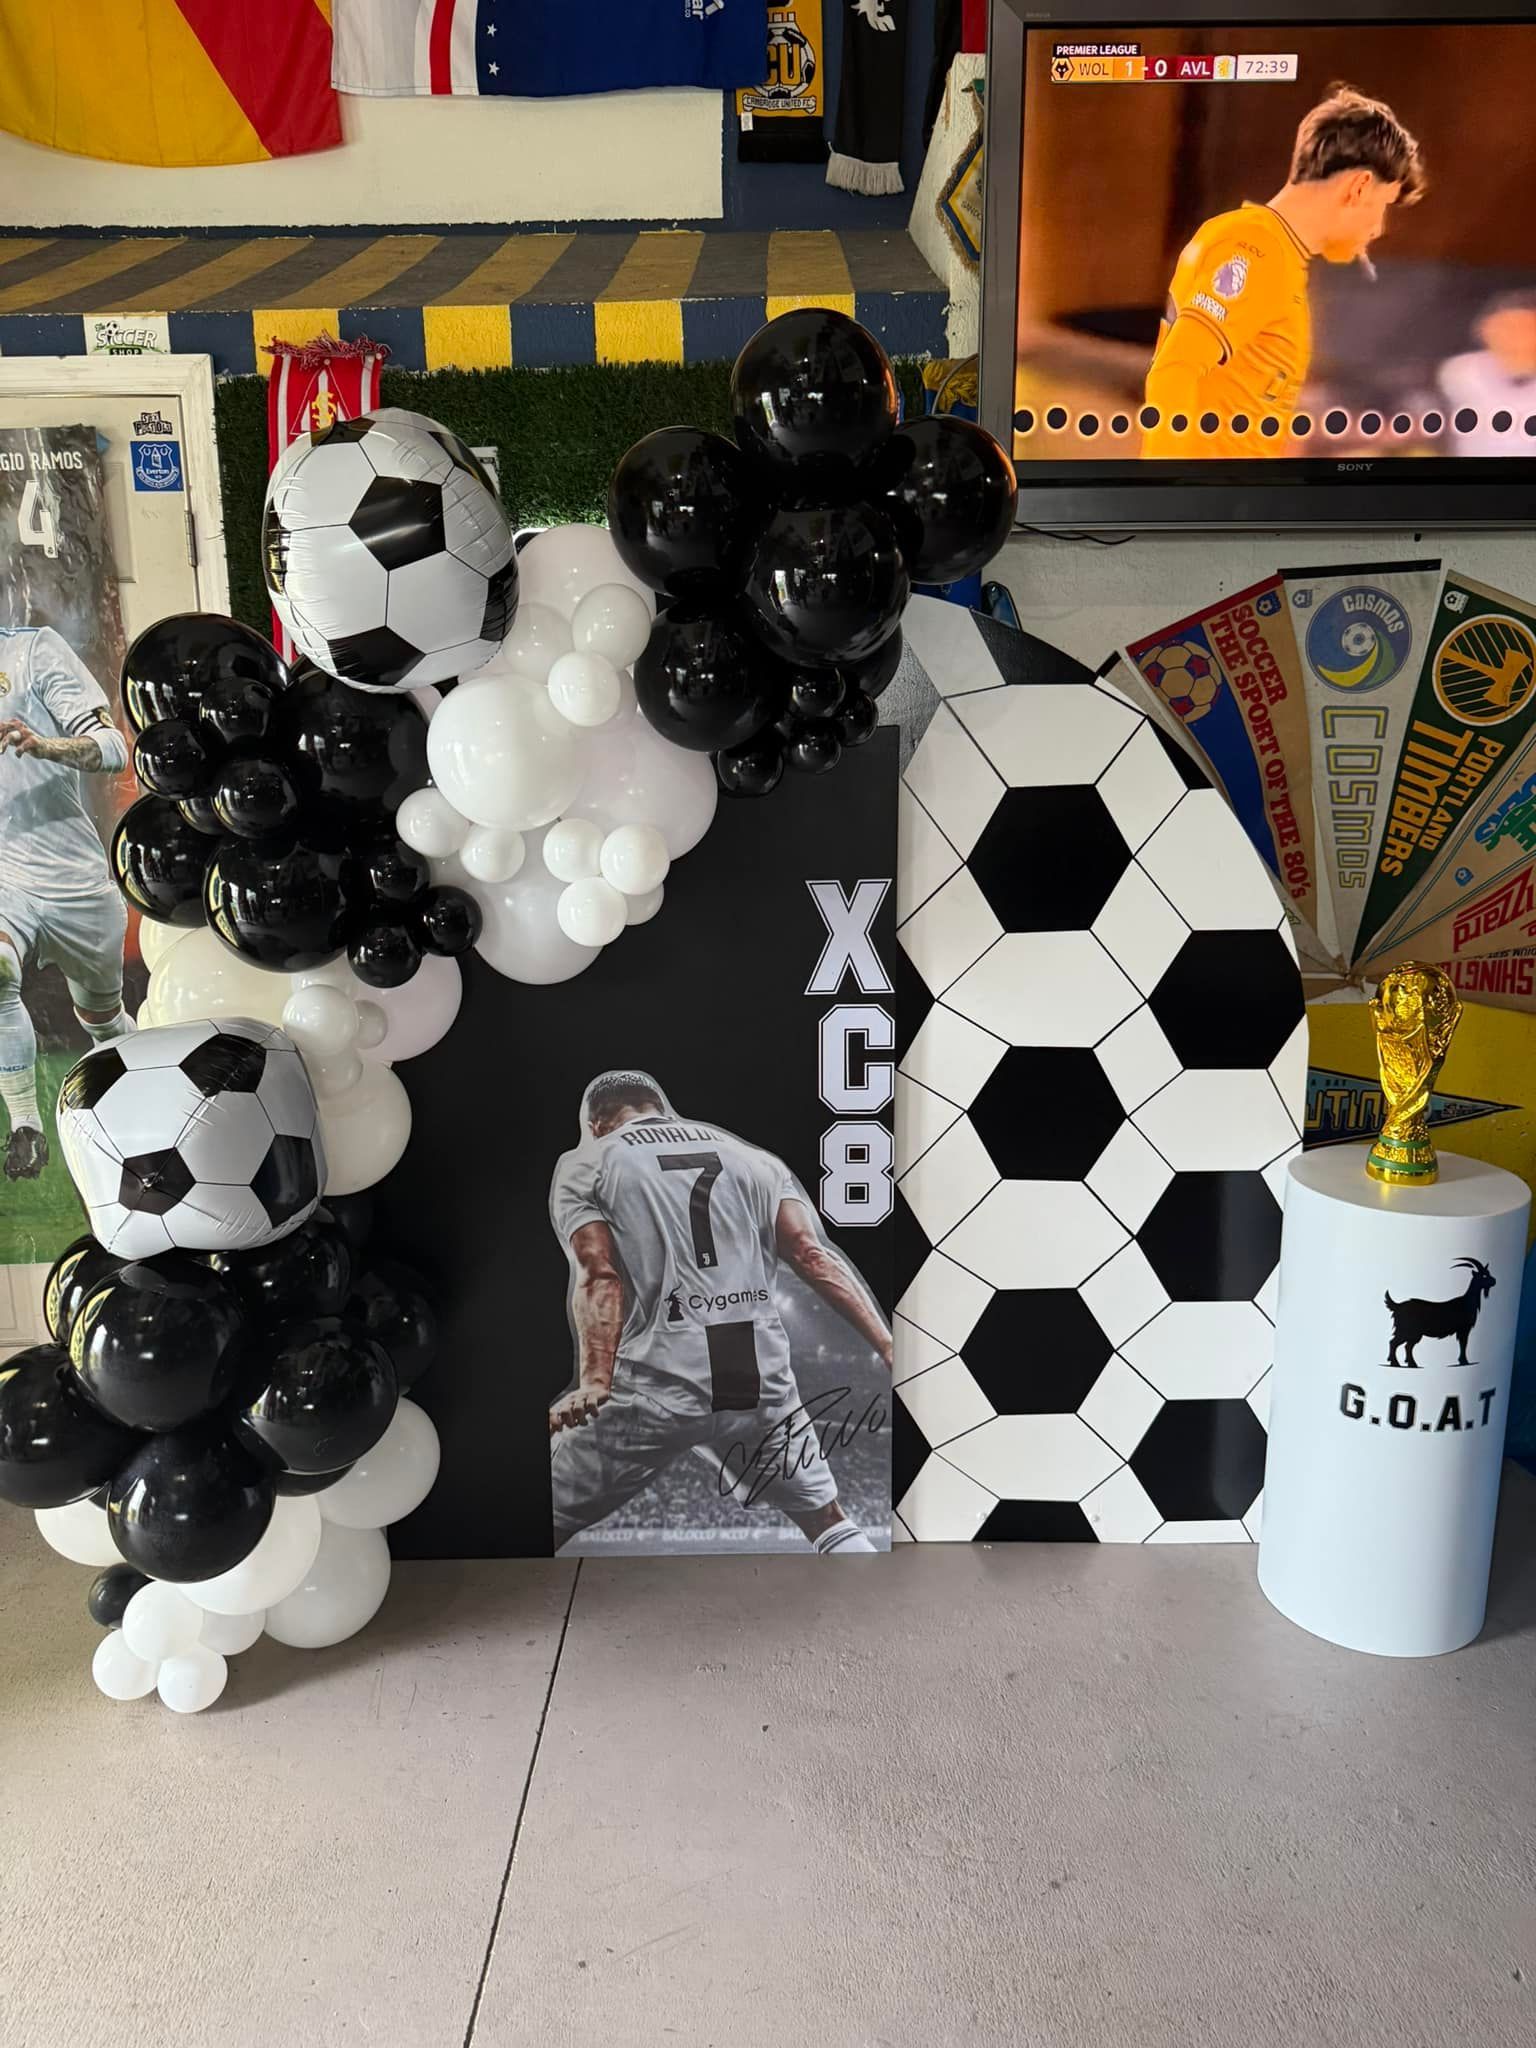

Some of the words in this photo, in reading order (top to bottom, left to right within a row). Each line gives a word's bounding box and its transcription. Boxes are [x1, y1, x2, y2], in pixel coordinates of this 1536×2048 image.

[1056, 45, 1098, 55] PREMIER
[1099, 45, 1137, 54] LEAGUE
[1080, 62, 1109, 76] WOL
[1180, 60, 1211, 76] AVL
[1245, 60, 1289, 74] 72:39
[31, 451, 84, 471] RAMOS
[1337, 463, 1374, 472] SONY
[17, 479, 59, 558] 4
[1342, 593, 1405, 634] COSMOS
[1209, 613, 1249, 671] THE
[1231, 604, 1288, 706] SOCCER
[1233, 671, 1281, 756] SPORT
[1264, 758, 1289, 791] OF
[1321, 705, 1389, 889] COSMOS
[1380, 719, 1475, 877] TIMBERS
[1418, 735, 1506, 851] PORTLAND
[1269, 791, 1301, 848] THE
[1283, 849, 1312, 899] 80's
[1304, 1088, 1386, 1129] UTIN
[656, 1150, 724, 1268] 7
[1340, 1382, 1497, 1431] G.O.A.T
